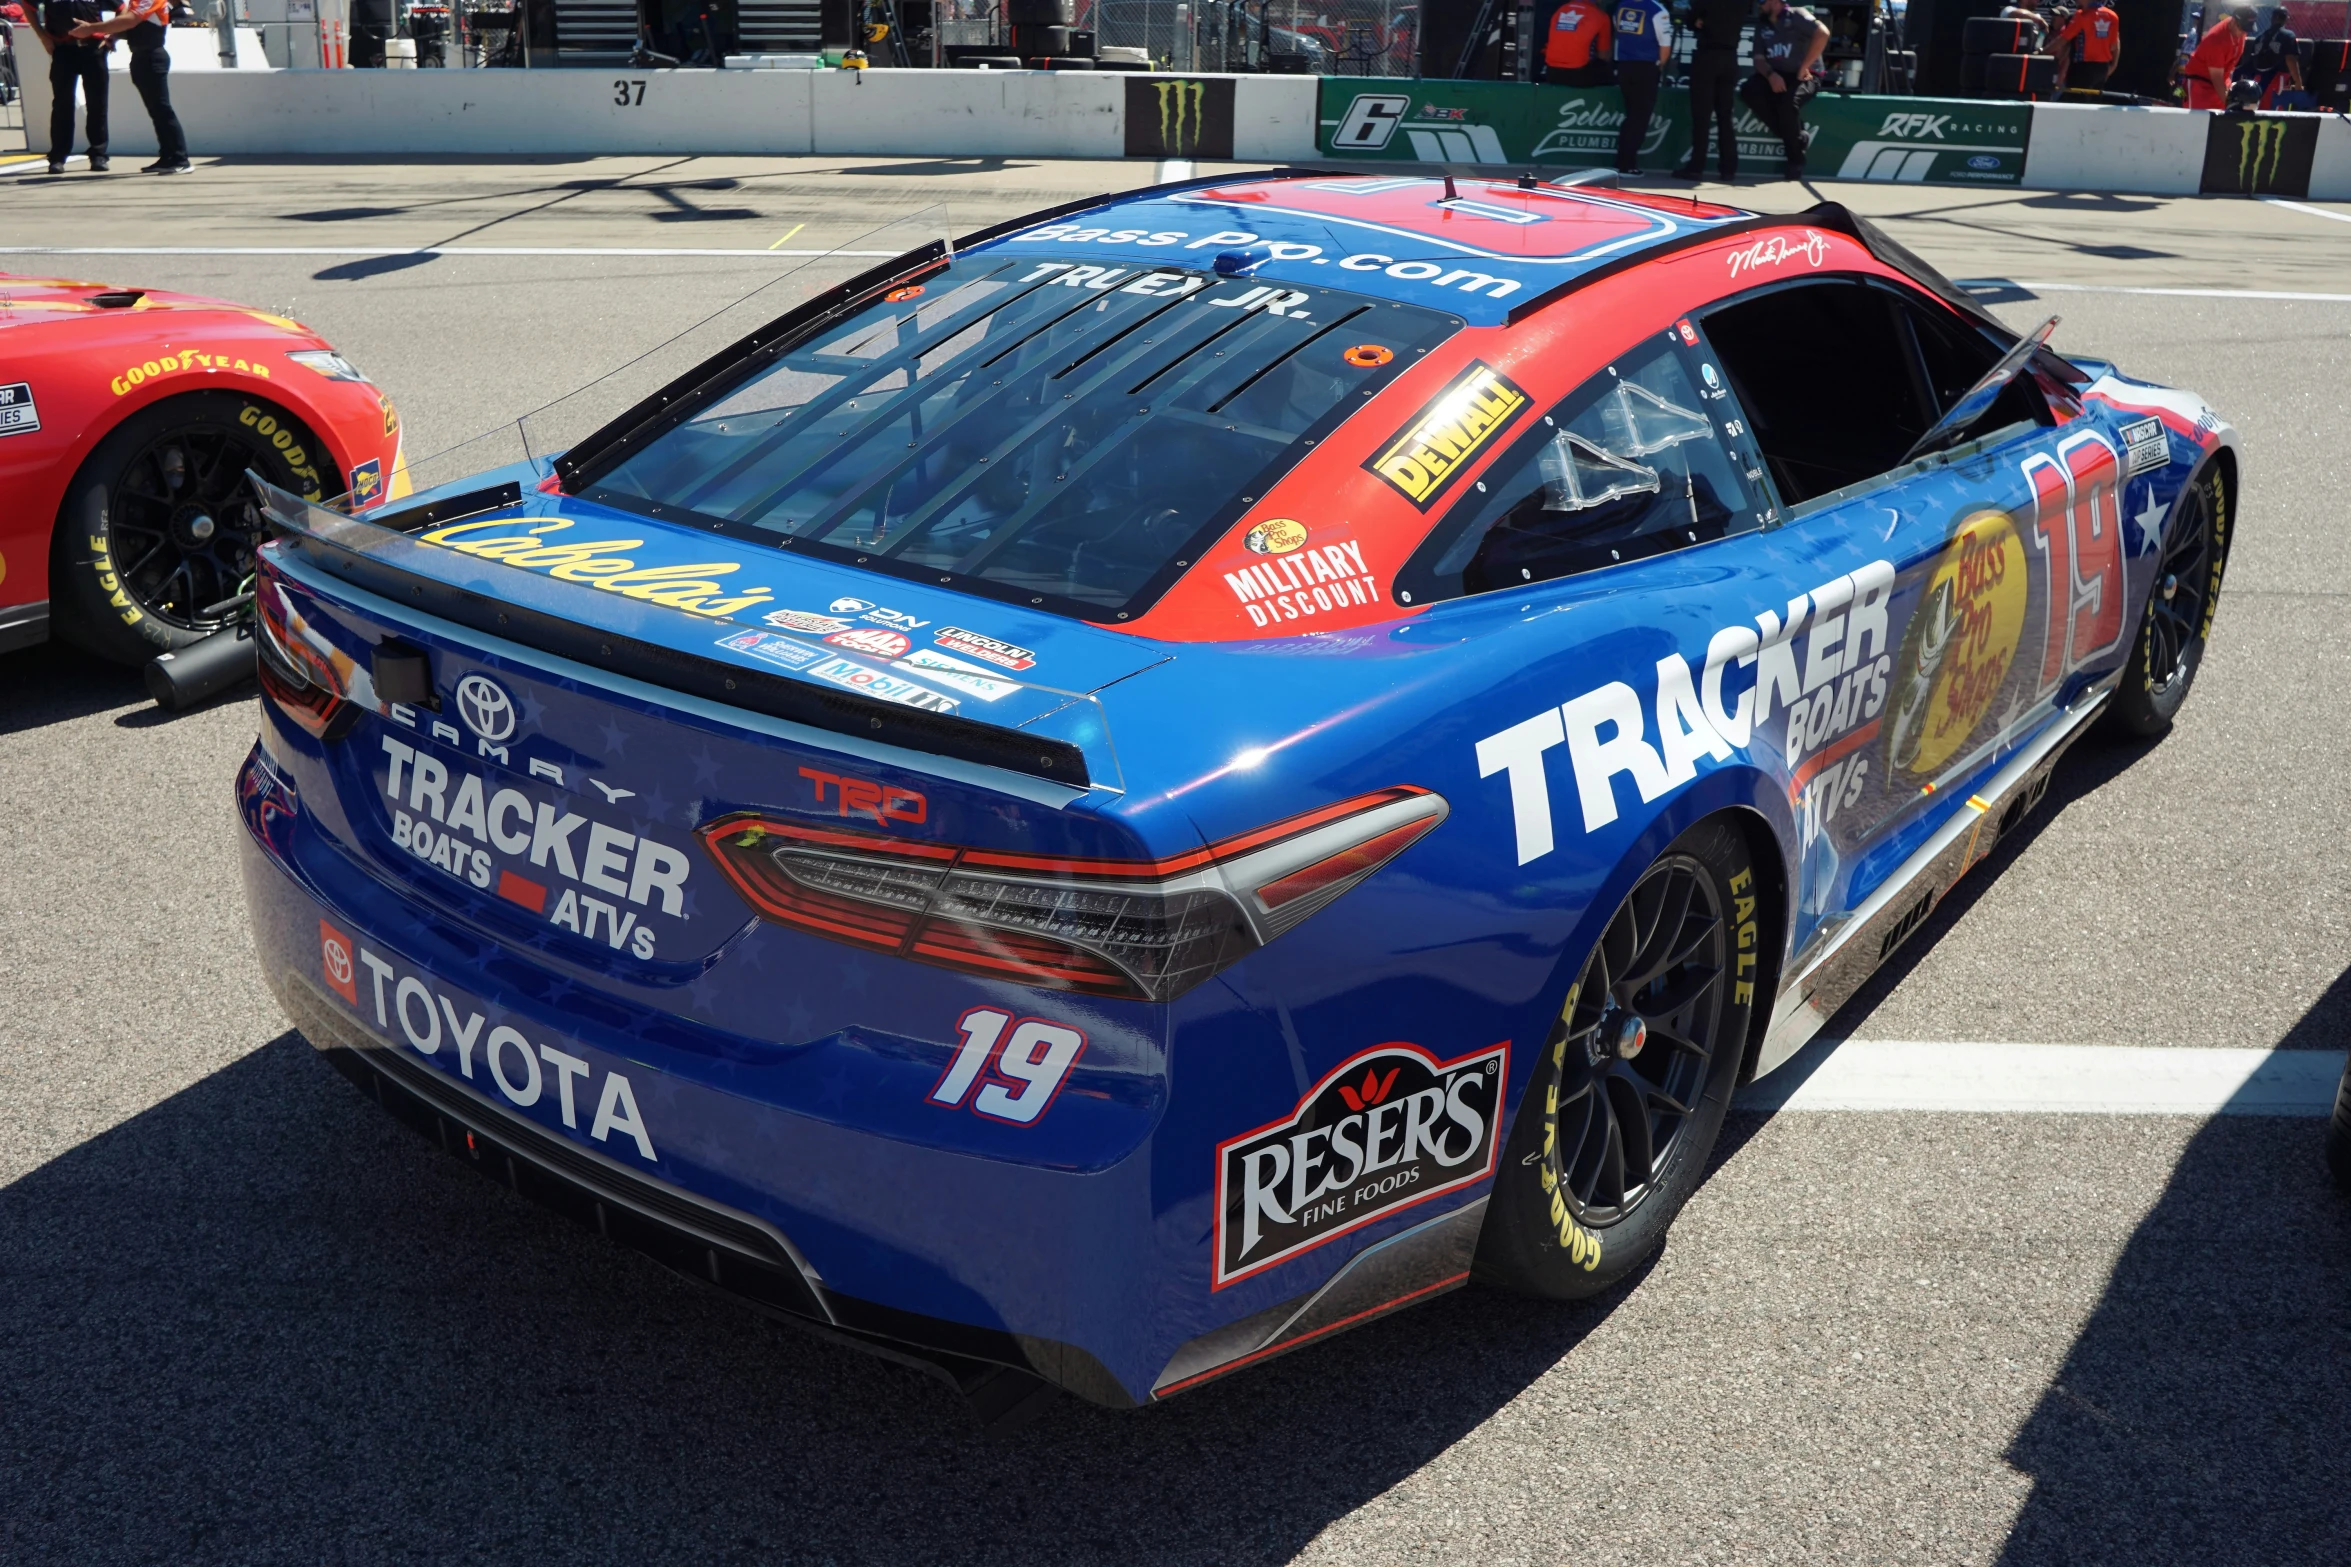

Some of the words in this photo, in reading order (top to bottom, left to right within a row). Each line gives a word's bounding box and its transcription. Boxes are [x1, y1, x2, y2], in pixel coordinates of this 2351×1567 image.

[1767, 43, 1793, 58] ally
[614, 80, 646, 106] 37
[1331, 94, 1411, 150] 6
[1559, 136, 1618, 148] PLUMBI
[1707, 141, 1786, 156] PMBING
[1876, 113, 1951, 139] RFK
[1951, 123, 2018, 134] RACING
[1014, 224, 1190, 246] Bass
[1018, 262, 1207, 302] TRUEX
[1208, 283, 1313, 319] JR.
[111, 349, 270, 396] GOODYEAR
[1379, 369, 1517, 498] DEWALT
[2132, 421, 2158, 442] NASCAR
[2141, 443, 2162, 461] SERIES
[1261, 520, 1287, 533] Bass
[1268, 530, 1287, 540] Pro
[1274, 534, 1304, 548] Shops
[90, 535, 143, 625] EAGLE
[414, 517, 775, 619] Cabela's
[1223, 540, 1369, 603] MILITARY
[1956, 530, 2007, 607] Bass
[2020, 428, 2127, 702] 19
[859, 614, 912, 632] SOLUTIONS
[1245, 576, 1380, 628] DISCOUNT
[840, 630, 906, 655] MAC
[943, 628, 1029, 659] LINCOLN
[947, 639, 1019, 668] WELDERS
[823, 662, 915, 697] Mobil
[1475, 559, 1896, 867] TRACKER
[1786, 654, 1890, 770] BOATS
[391, 702, 636, 804] CAMRY
[798, 766, 927, 828] TRD
[1801, 752, 1869, 864] ATVs
[382, 734, 690, 919] TRACKER
[392, 809, 492, 888] BOATS
[549, 888, 656, 961] ATVs
[1729, 866, 1757, 1007] EAGLE
[360, 948, 658, 1162] TOYOTA
[924, 1005, 1089, 1128] 19
[1238, 1071, 1484, 1262] RESER'S
[1303, 1195, 1347, 1227] FINE
[1354, 1166, 1420, 1206] FOODS
